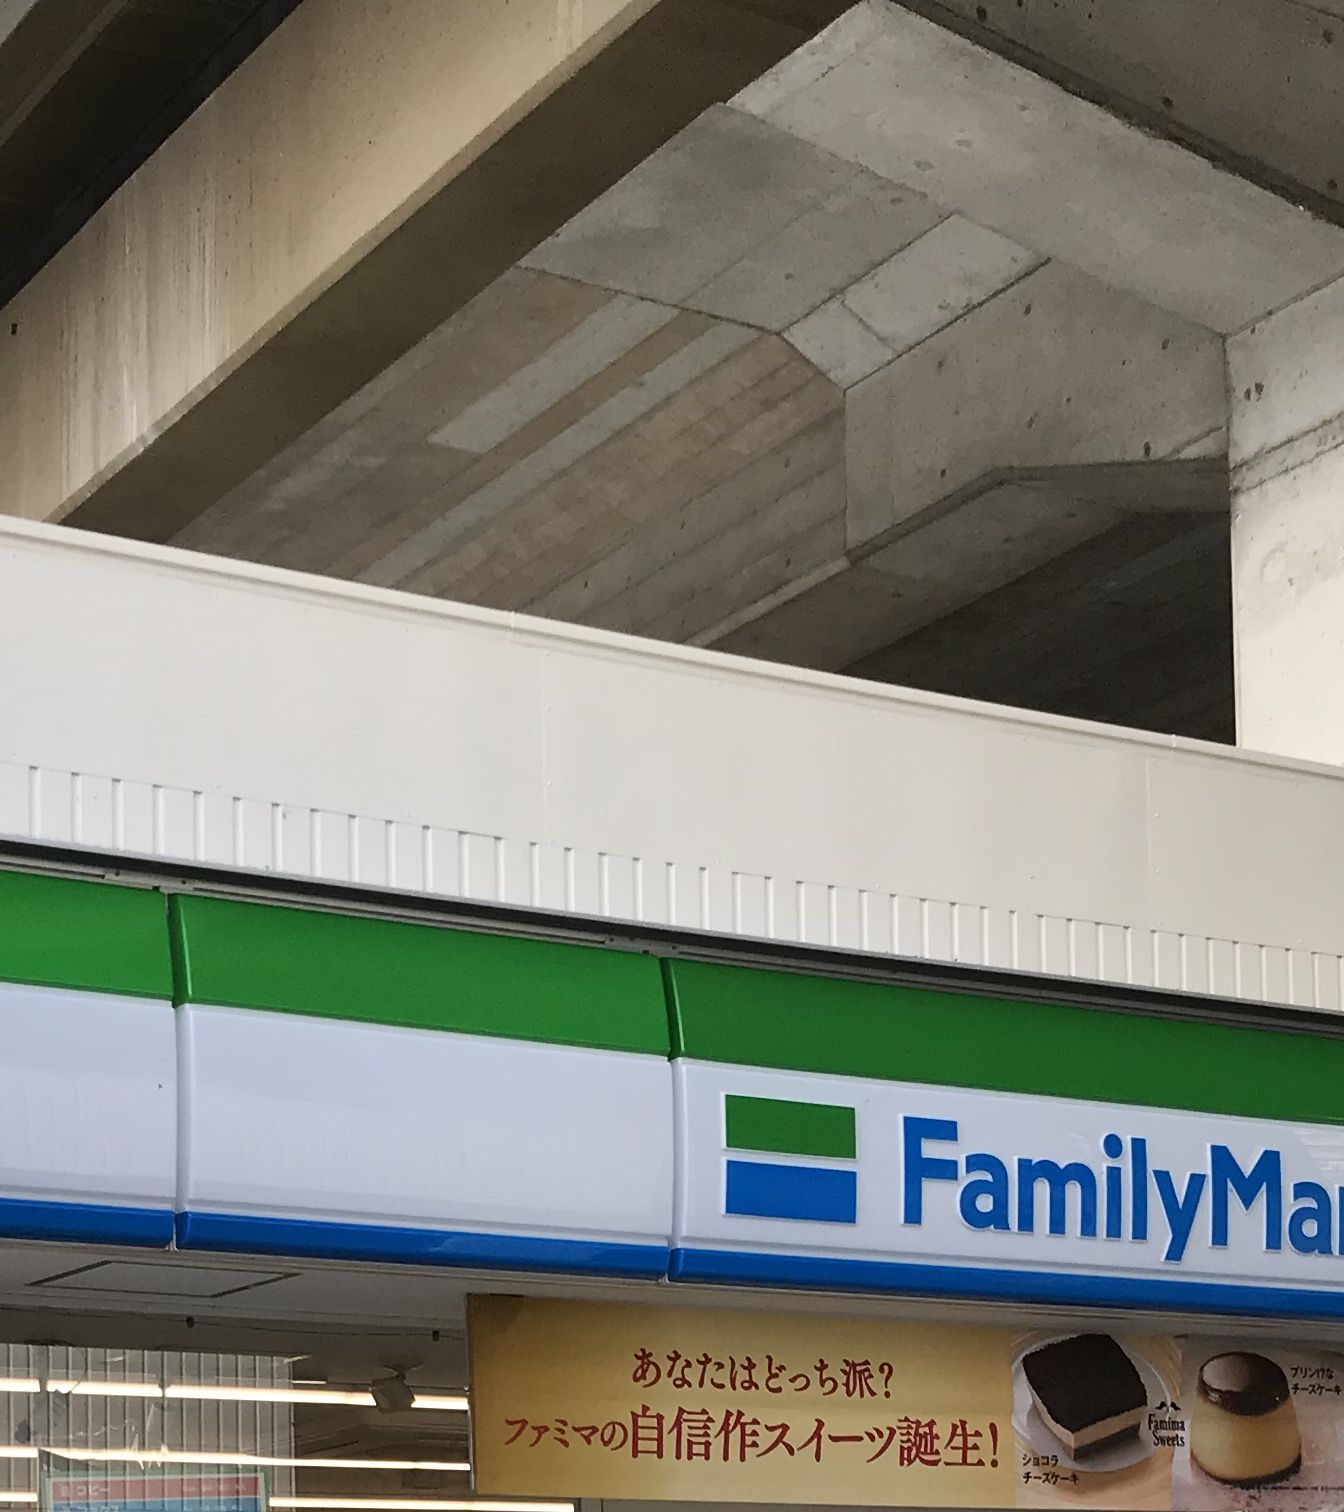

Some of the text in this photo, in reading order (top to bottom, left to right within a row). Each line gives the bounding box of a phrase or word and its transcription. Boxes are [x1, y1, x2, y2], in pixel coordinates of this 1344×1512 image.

[632, 1347, 894, 1399] あなたはどっち派?
[1292, 1385, 1342, 1396] チーズケーキ
[1148, 1414, 1186, 1432] Famima
[504, 1404, 999, 1469] ファミマの自信作スイーツ誕生!
[1153, 1433, 1186, 1447] Sweets
[1022, 1455, 1059, 1467] ショコラ
[1023, 1471, 1078, 1485] チーズケーキ
